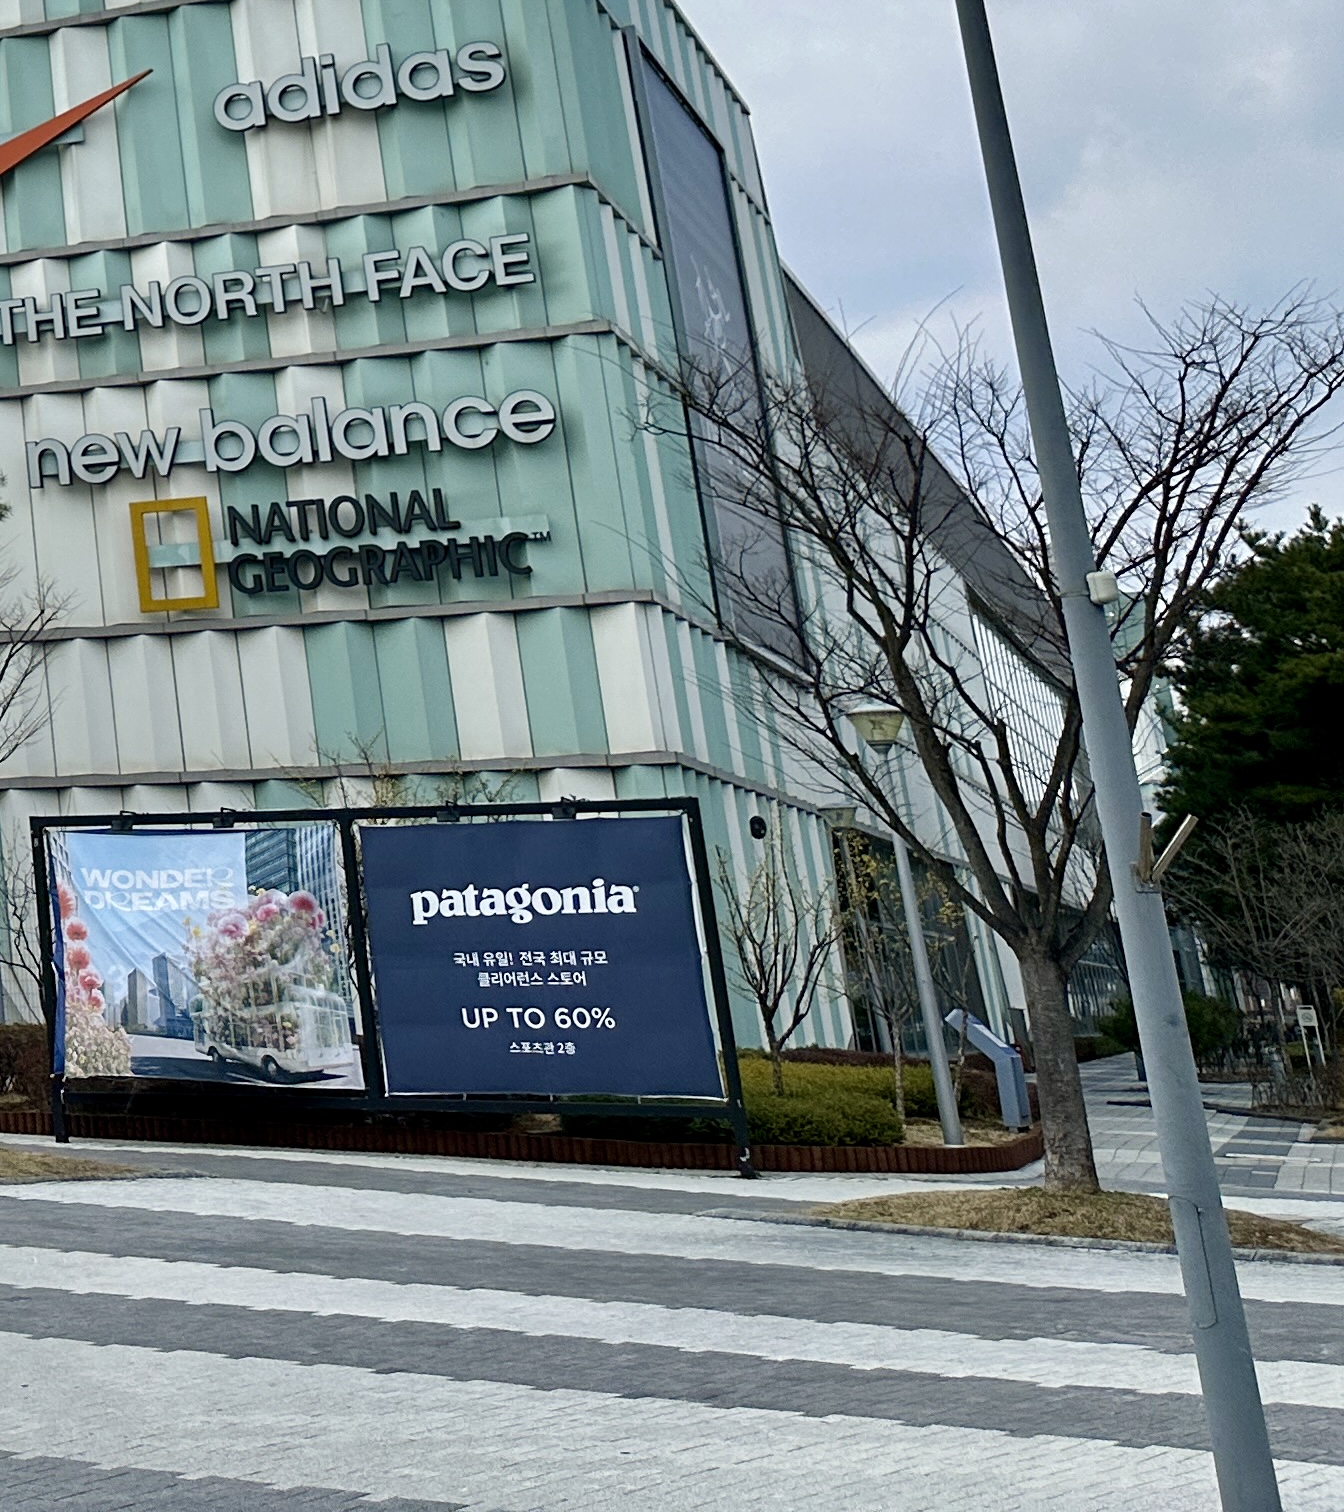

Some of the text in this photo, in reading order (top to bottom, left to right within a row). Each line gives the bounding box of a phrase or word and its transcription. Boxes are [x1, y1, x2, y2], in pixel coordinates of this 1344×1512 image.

[213, 40, 506, 131] adidas
[120, 257, 346, 331] NORTH
[362, 233, 536, 302] FACE
[25, 390, 556, 488] new balance
[226, 488, 461, 547] NATIONAL
[228, 531, 533, 594] GEOGRAPHIC
[80, 867, 235, 889] WONDER
[84, 890, 236, 912] DREAMS
[410, 878, 637, 925] patagonia
[453, 950, 608, 967] 국내 유일! 전국 최대 규모
[547, 971, 587, 986] 스토어
[461, 1007, 616, 1029] UP TO 60%
[509, 1042, 555, 1055] 스포츠관
